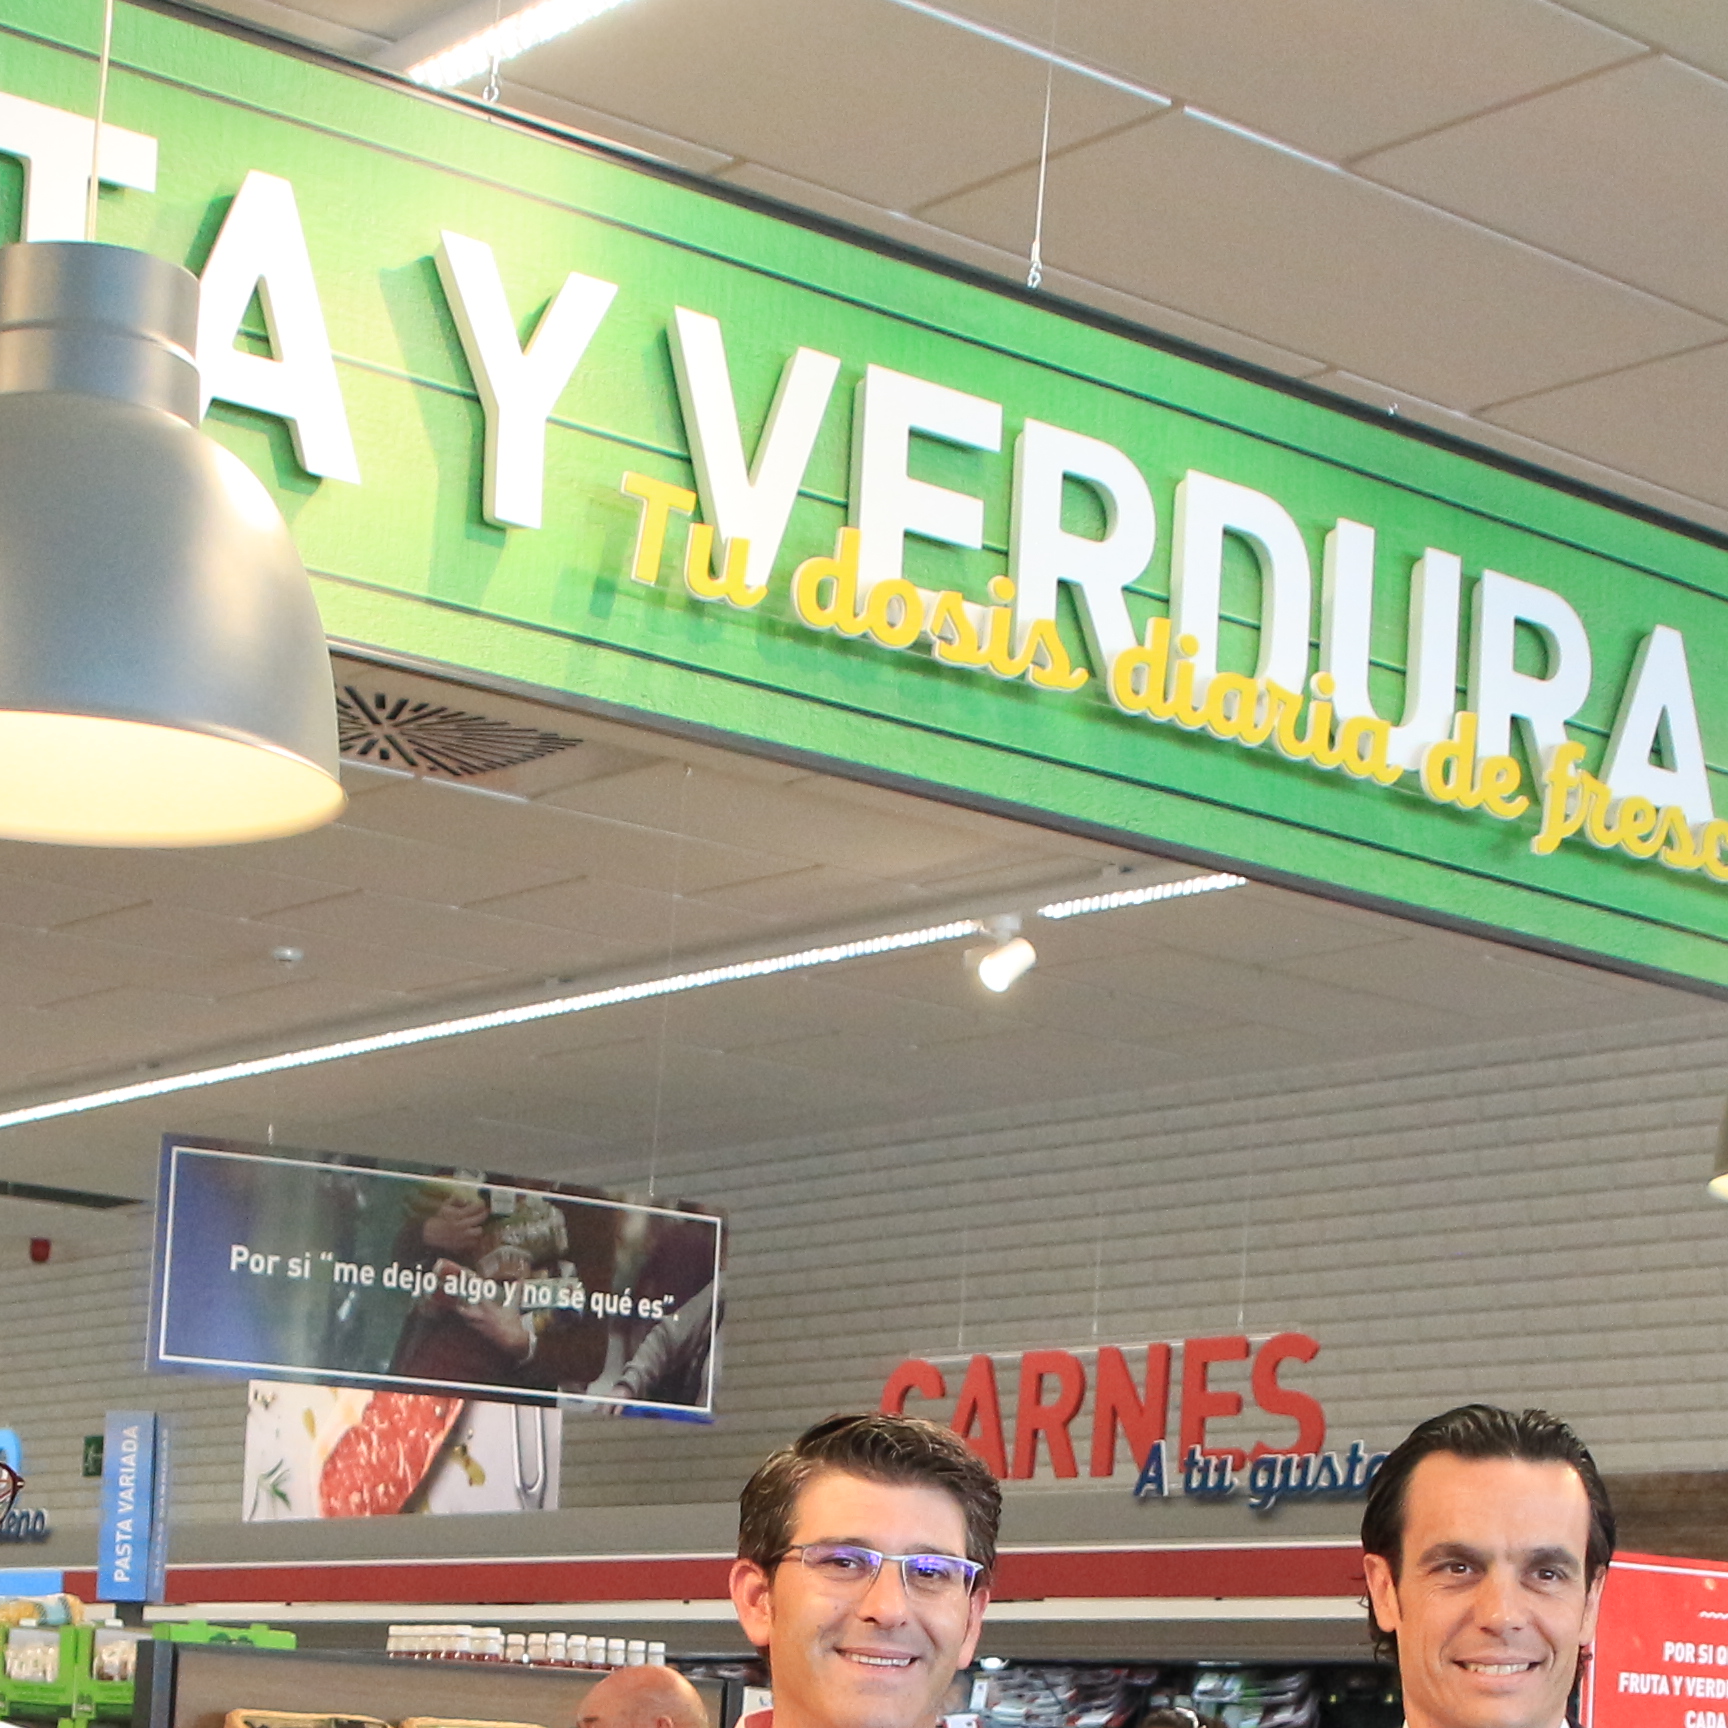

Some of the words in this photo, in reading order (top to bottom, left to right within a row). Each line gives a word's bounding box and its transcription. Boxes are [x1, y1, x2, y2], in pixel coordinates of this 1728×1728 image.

[437, 229, 618, 529] Y
[671, 305, 1712, 826] VERDURA
[621, 473, 765, 607] Tu
[792, 529, 1087, 690] dosis
[1111, 619, 1404, 789] diaria
[1424, 713, 1530, 821] de
[228, 1244, 279, 1275] Por
[287, 1251, 312, 1279] si
[382, 1260, 438, 1298] dejo
[444, 1269, 496, 1305] algo
[502, 1280, 518, 1308] y
[523, 1282, 552, 1306] no
[558, 1279, 585, 1311] sé
[590, 1286, 632, 1319] qué
[118, 1424, 139, 1513] VARIADA
[1134, 1438, 1169, 1498] A
[1183, 1441, 1236, 1497] tu
[113, 1519, 134, 1583] PASTA
[1618, 1672, 1669, 1696] FRUTA
[1672, 1675, 1683, 1696] Y
[1663, 1641, 1695, 1664] POR
[1697, 1644, 1713, 1665] SI
